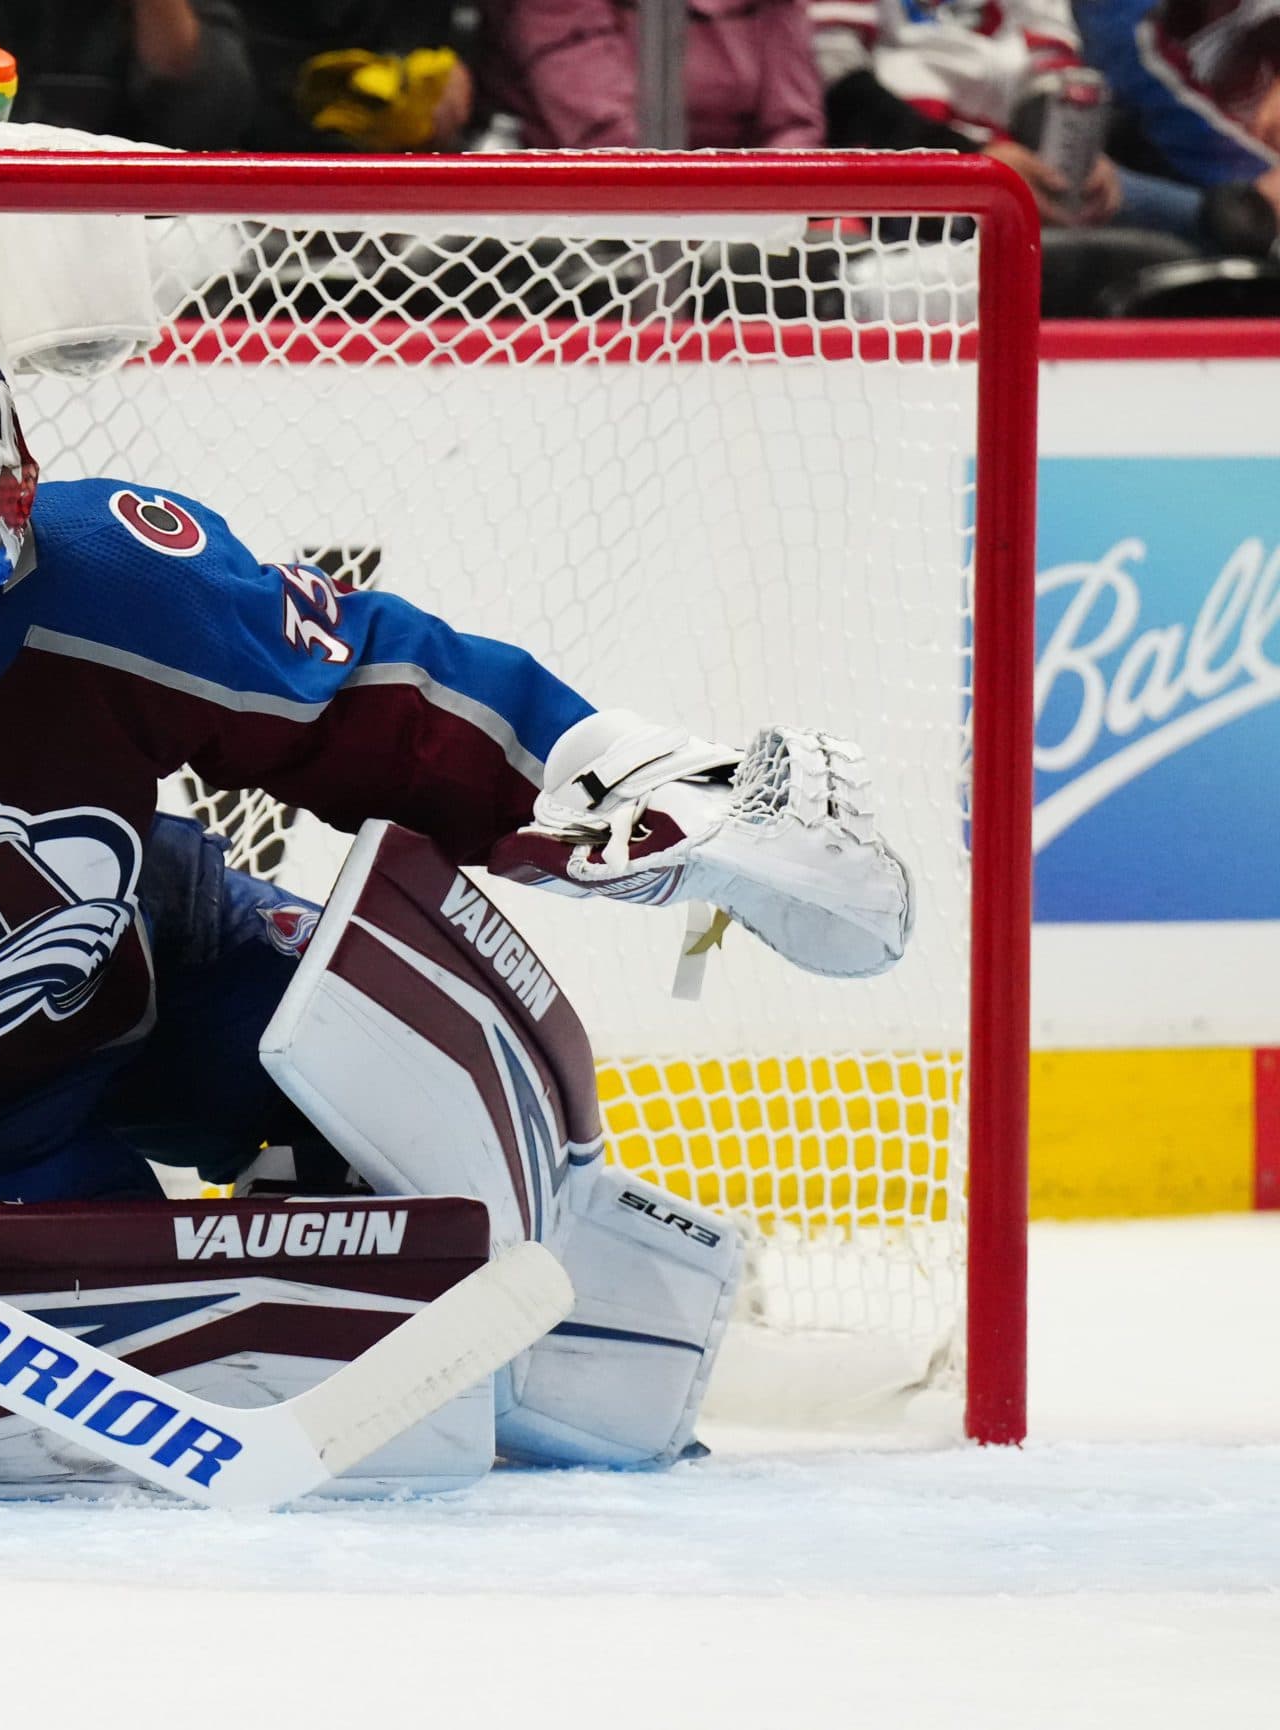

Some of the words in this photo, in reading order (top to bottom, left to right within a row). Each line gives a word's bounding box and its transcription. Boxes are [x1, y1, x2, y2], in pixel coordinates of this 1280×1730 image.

[439, 872, 559, 1022] VAUGHN
[173, 1210, 408, 1260] VAUGHN
[618, 1191, 720, 1248] SLR3
